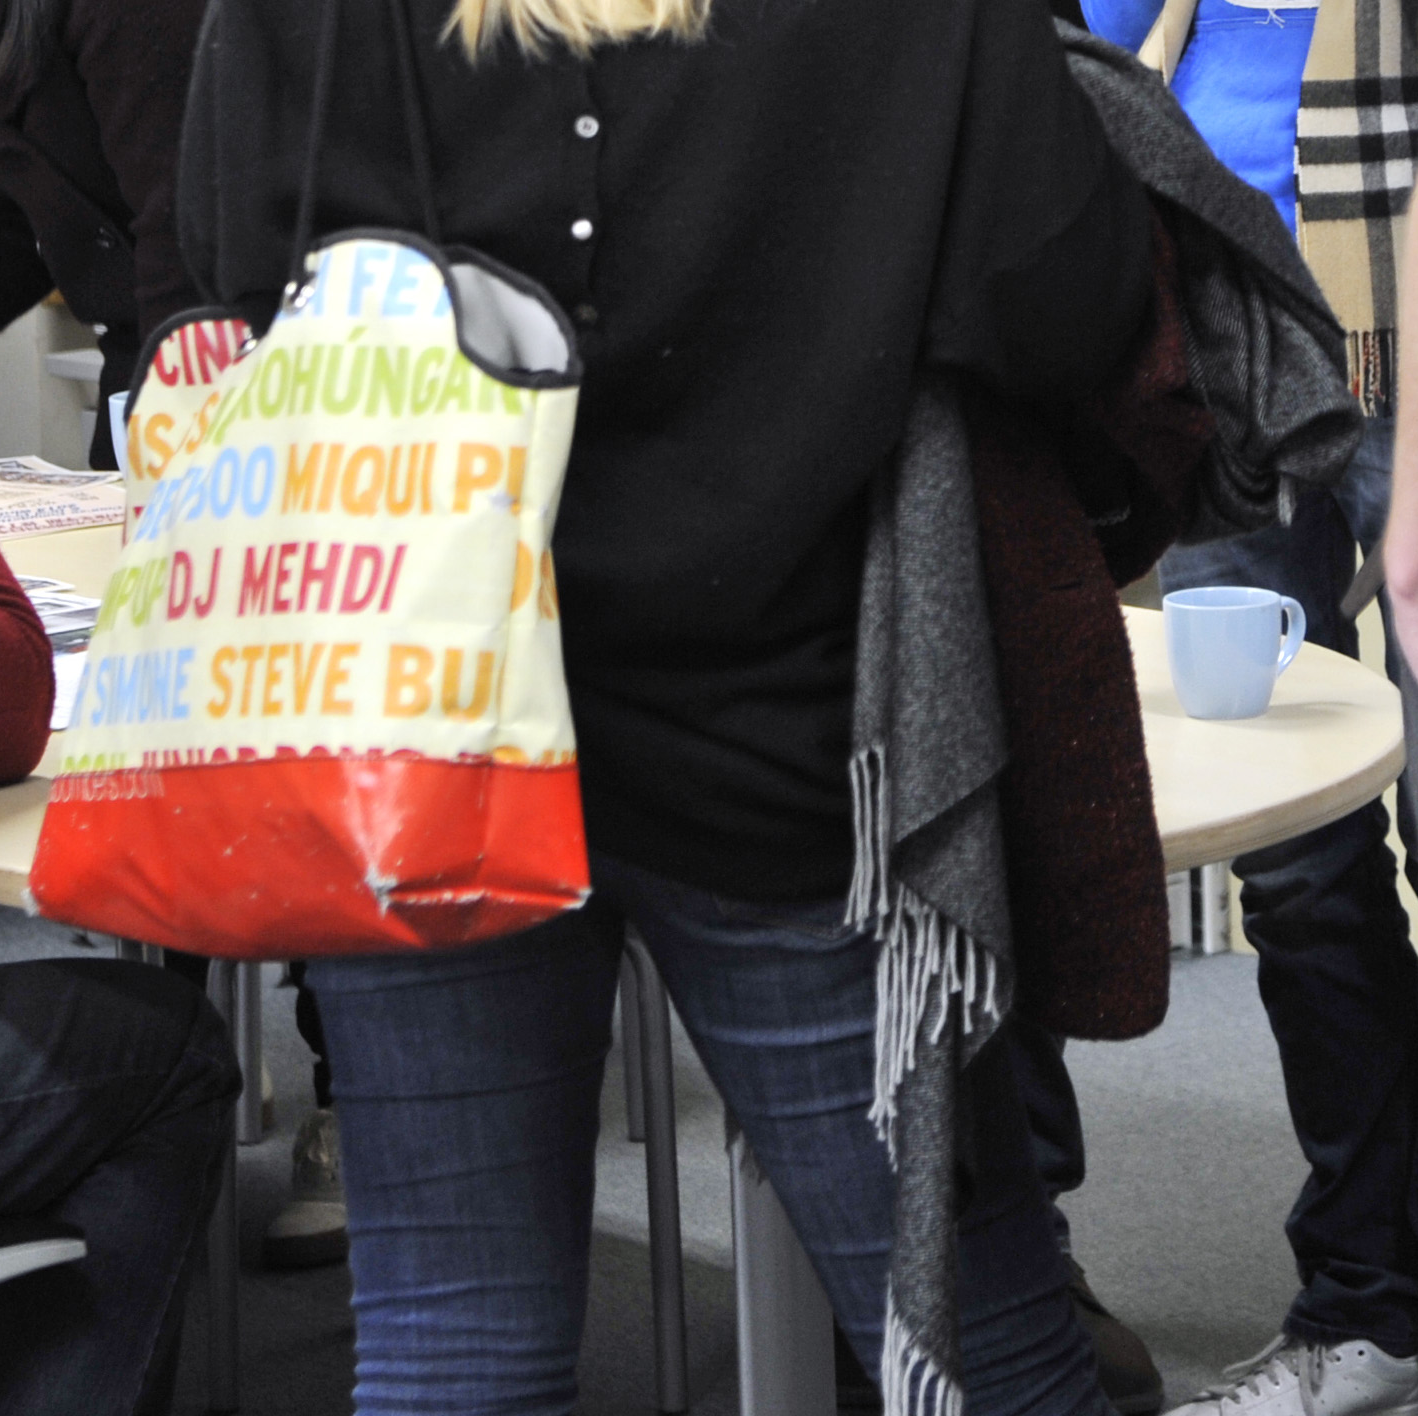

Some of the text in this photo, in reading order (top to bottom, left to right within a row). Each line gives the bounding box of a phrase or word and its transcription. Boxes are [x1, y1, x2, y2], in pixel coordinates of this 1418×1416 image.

[280, 442, 439, 517] MIQUI
[168, 547, 222, 621] DJ
[237, 542, 409, 617] MEHDI
[207, 642, 362, 719] STEVE
[383, 644, 505, 721] BU
